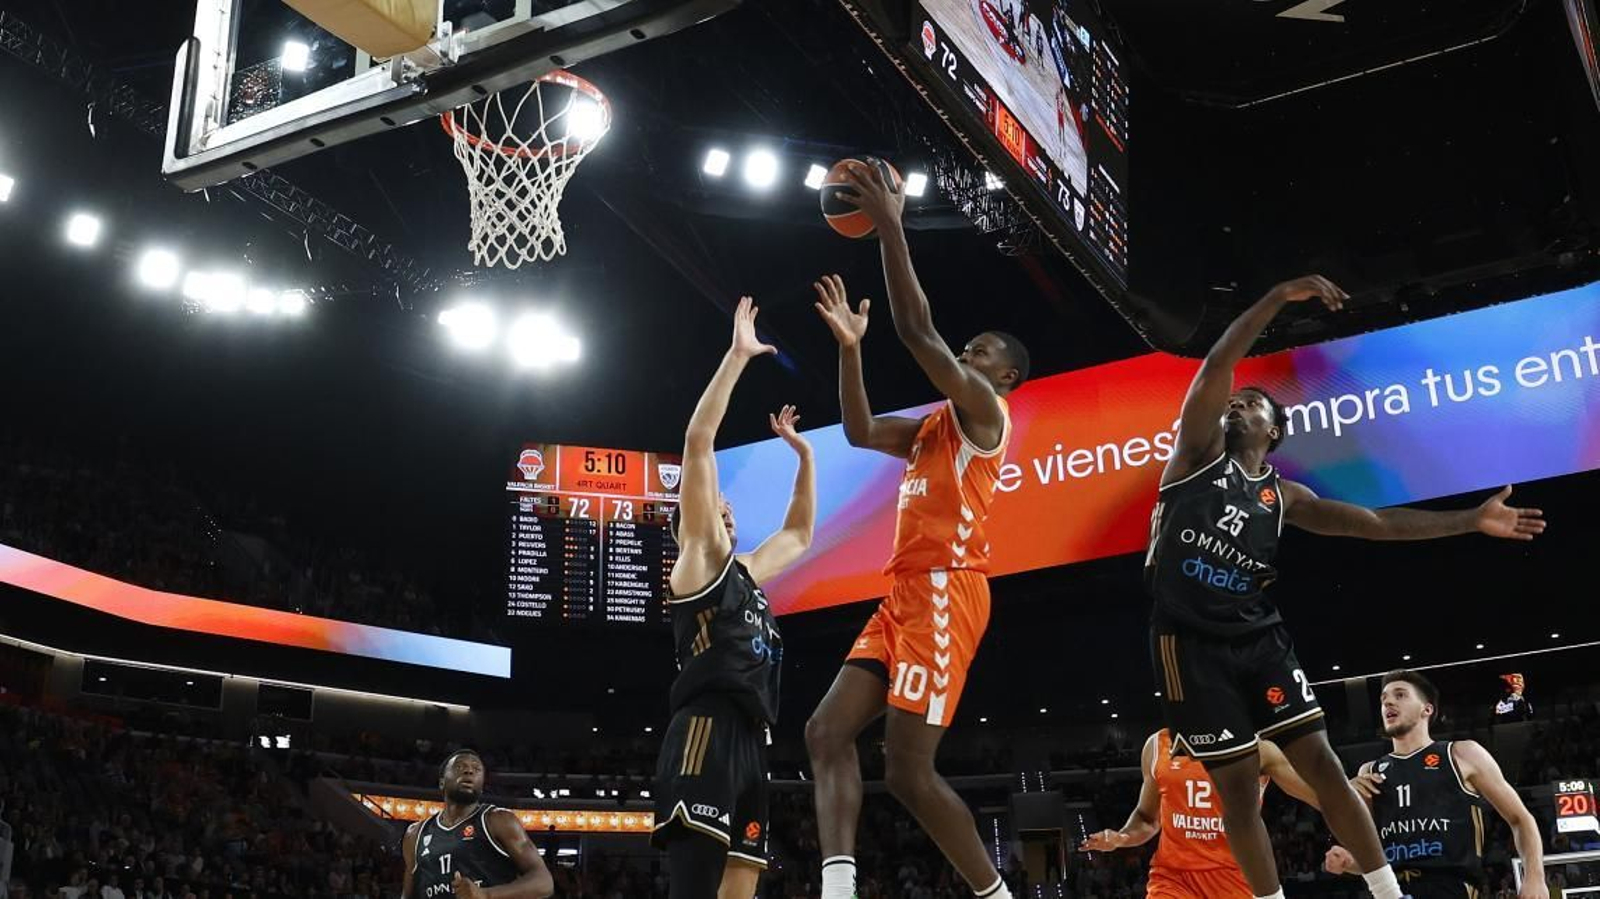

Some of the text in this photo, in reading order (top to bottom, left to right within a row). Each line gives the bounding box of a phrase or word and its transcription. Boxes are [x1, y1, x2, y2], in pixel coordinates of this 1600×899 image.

[940, 41, 957, 81] 72
[1057, 179, 1071, 211] 73
[1421, 364, 1501, 407] tus
[584, 451, 626, 475] 5:10
[1033, 420, 1181, 484] vienes
[596, 481, 627, 491] QUART
[519, 496, 541, 504] FALTES
[568, 498, 590, 518] 72
[612, 500, 633, 520] 73
[1216, 504, 1250, 537] 25
[1182, 557, 1251, 592] dnata
[516, 600, 547, 609] COSTELLO
[517, 592, 552, 600] THOMPSON
[614, 589, 652, 598] ARMSTRONG
[516, 609, 542, 618] NOGUES
[893, 661, 928, 701] 10
[1185, 779, 1212, 809] 12
[1396, 784, 1411, 807] 11
[1558, 780, 1585, 792] 5:09
[1558, 794, 1588, 816] 20
[1185, 830, 1217, 840] BASKET
[1385, 839, 1443, 862] dnata
[439, 853, 451, 875] 17
